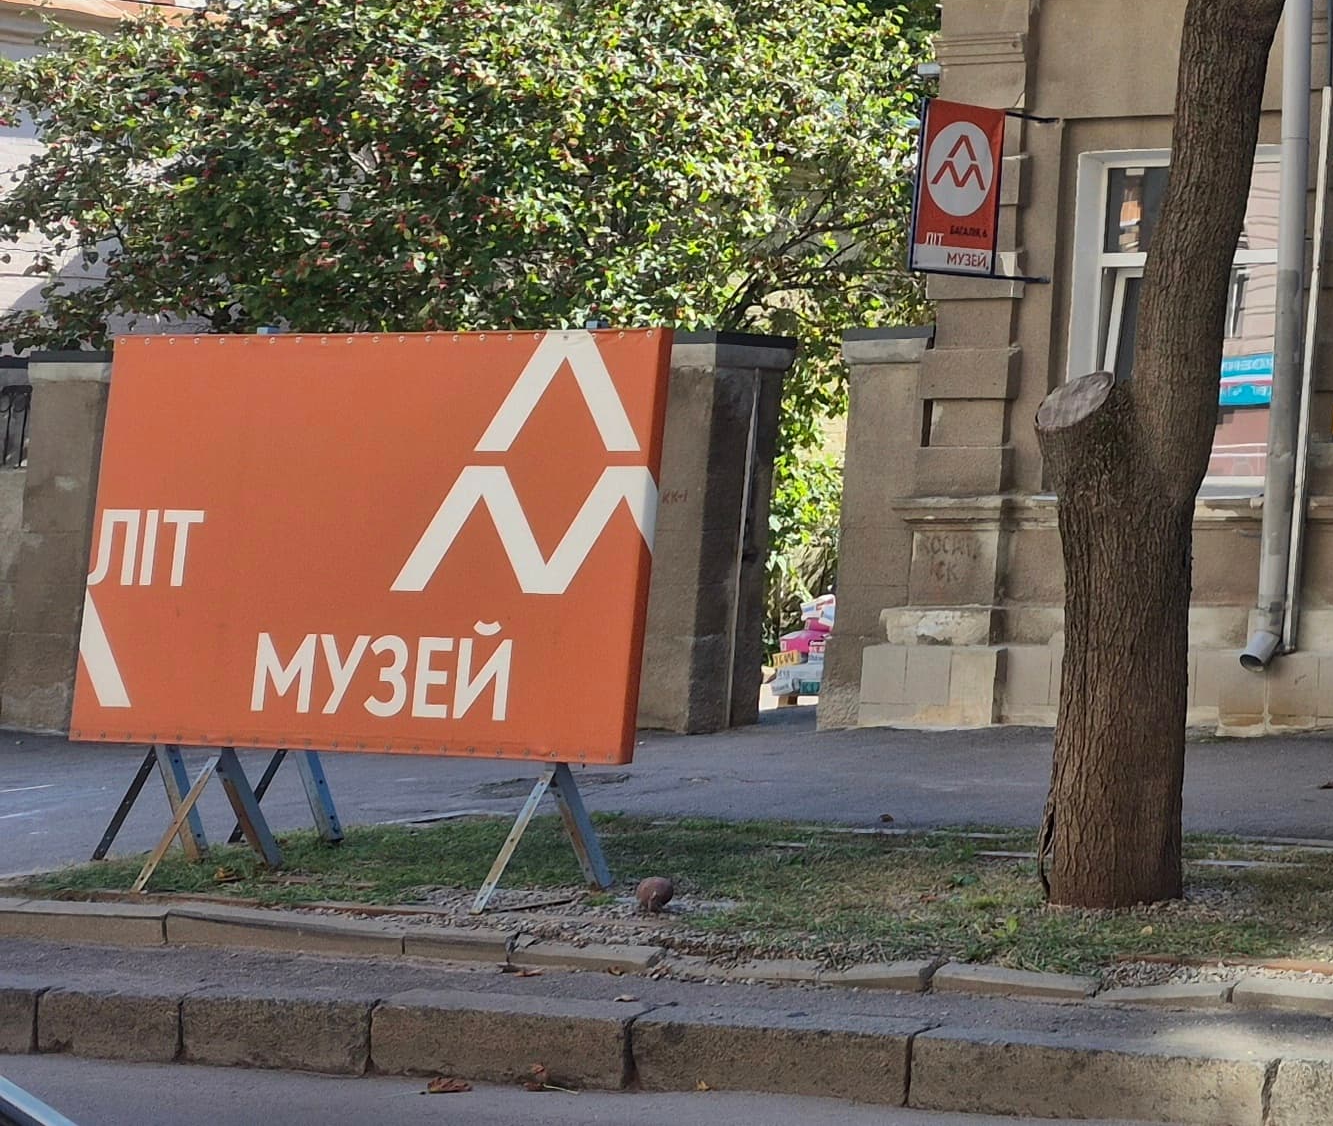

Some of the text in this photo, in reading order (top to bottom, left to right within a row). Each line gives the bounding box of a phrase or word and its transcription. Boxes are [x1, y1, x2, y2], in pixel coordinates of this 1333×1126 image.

[924, 231, 945, 246] ЛІТ
[87, 509, 205, 586] ЛІТ
[250, 620, 513, 721] МУЗЕЙ
